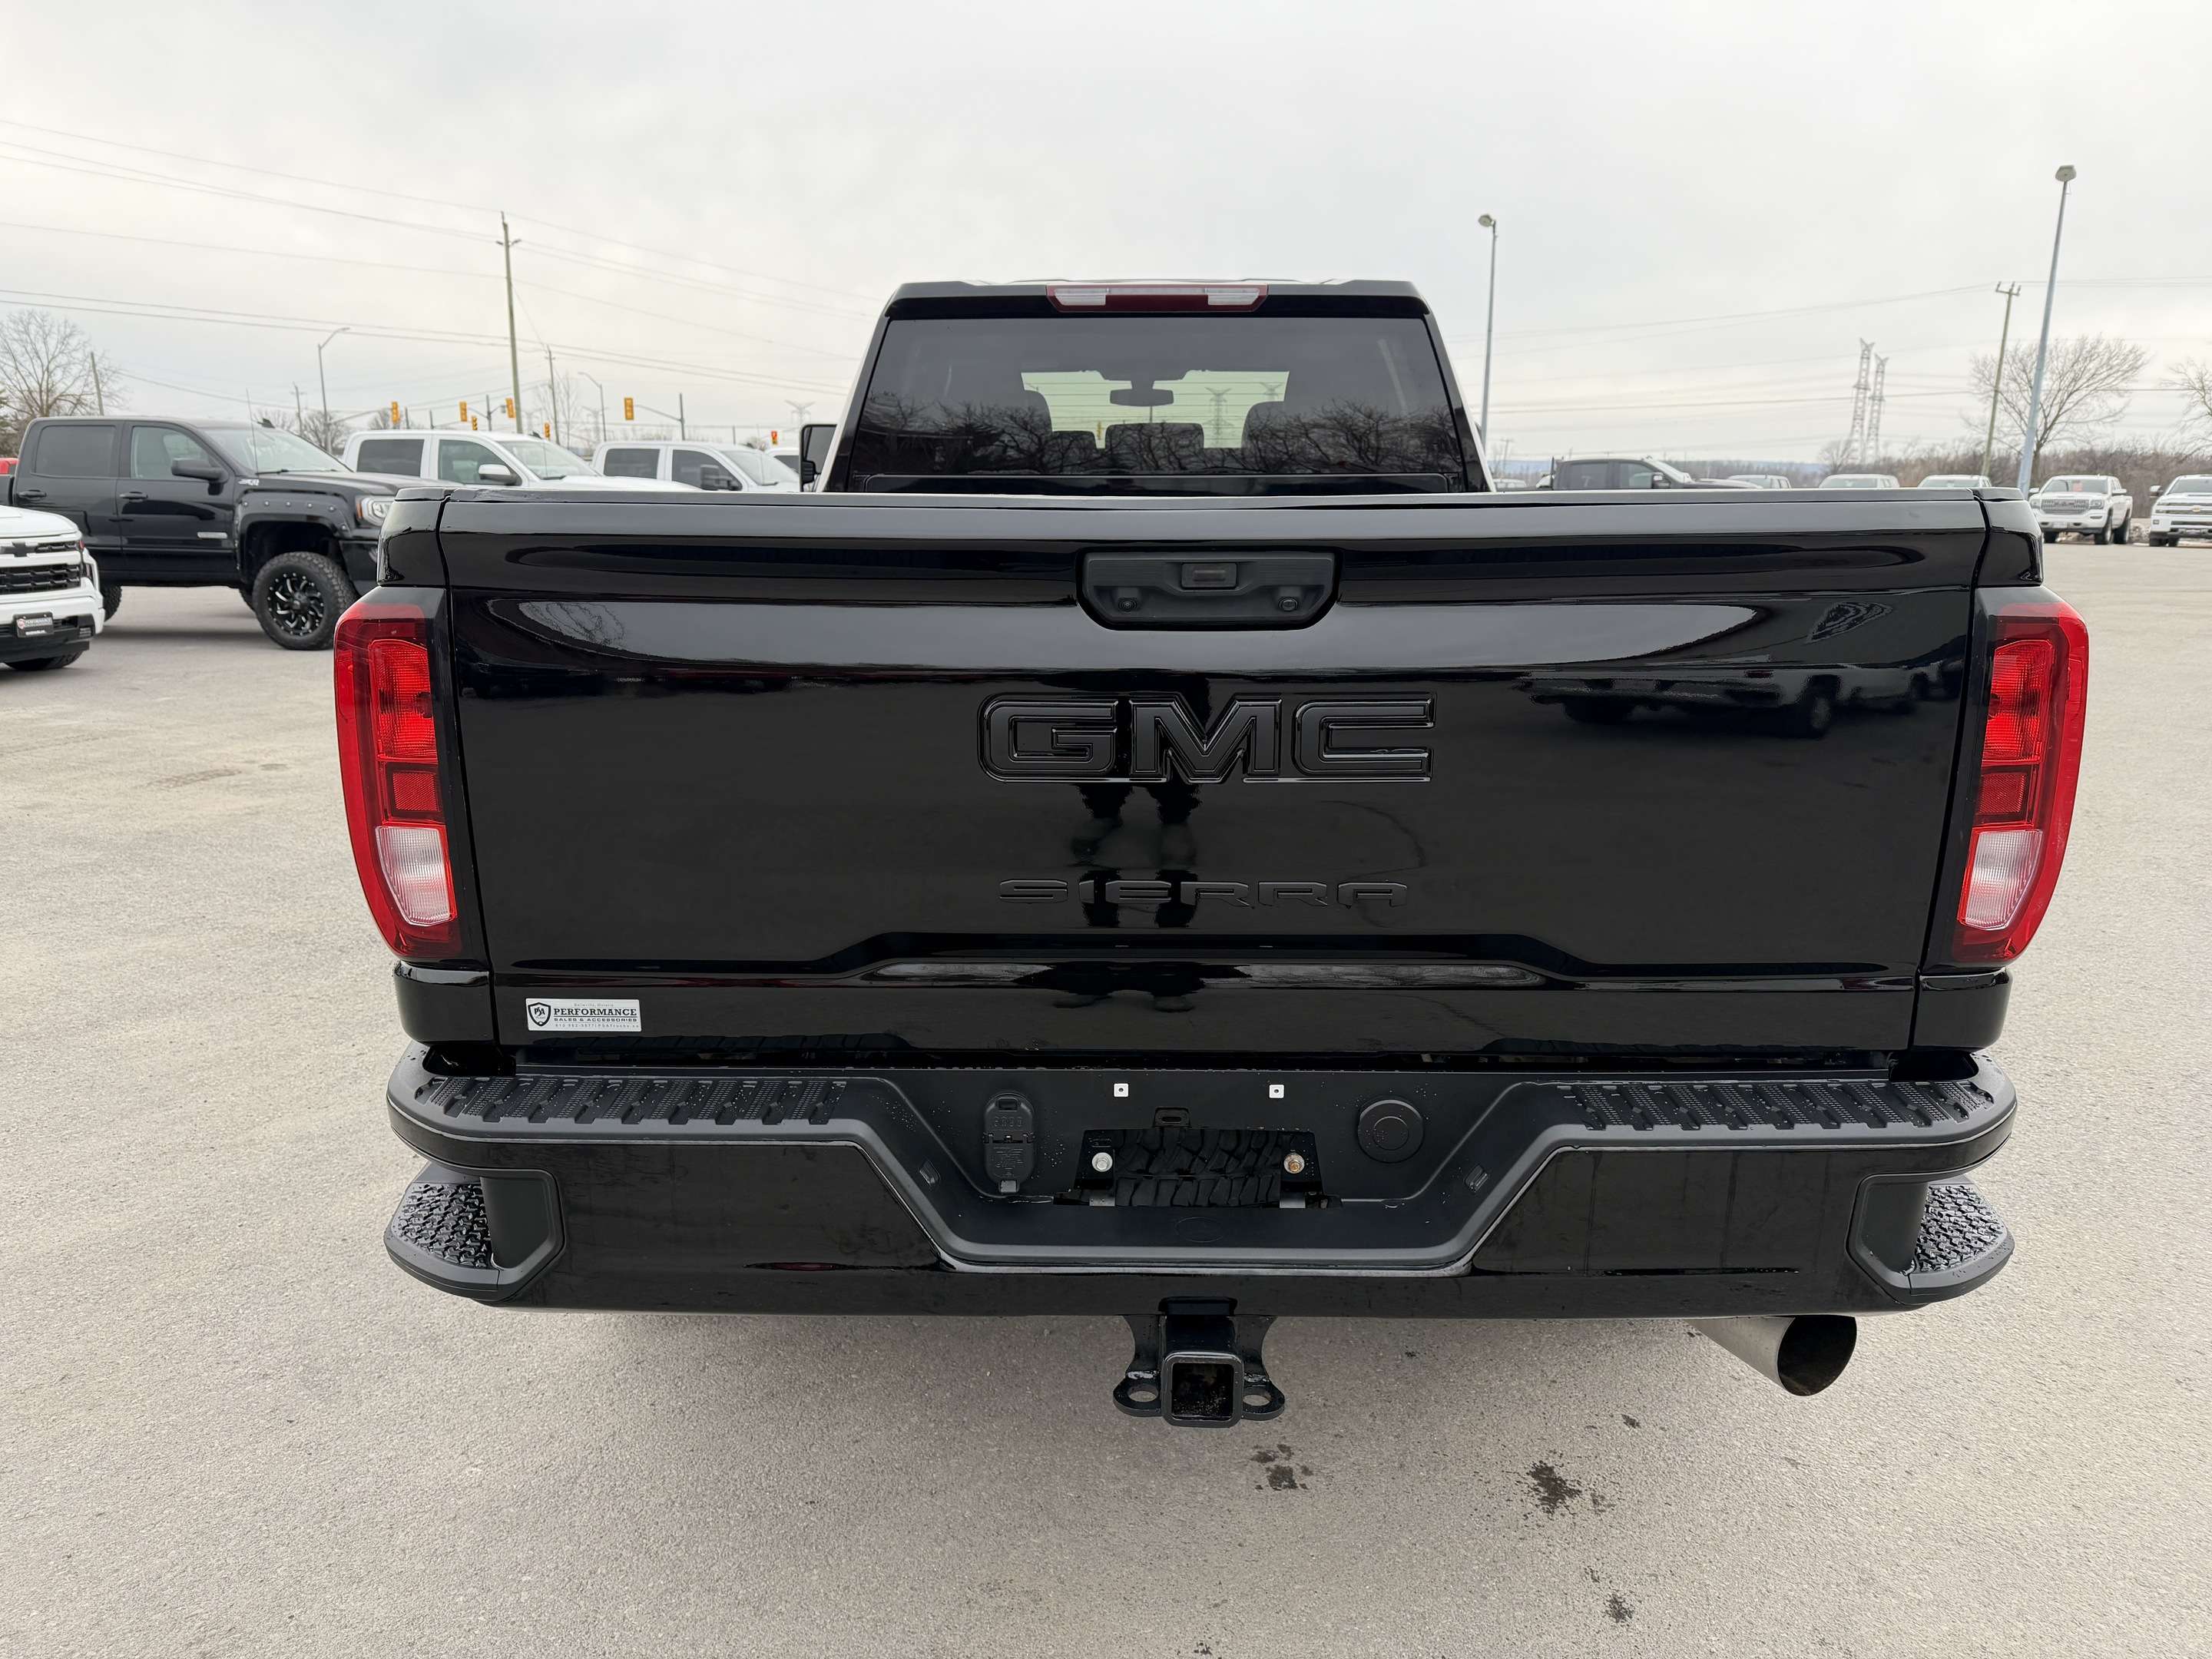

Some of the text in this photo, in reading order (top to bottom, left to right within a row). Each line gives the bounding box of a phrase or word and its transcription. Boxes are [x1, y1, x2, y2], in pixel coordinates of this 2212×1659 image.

[978, 691, 1436, 784] GMC
[999, 879, 1408, 909] SIERRA
[554, 1008, 637, 1016] PERFORMANCE
